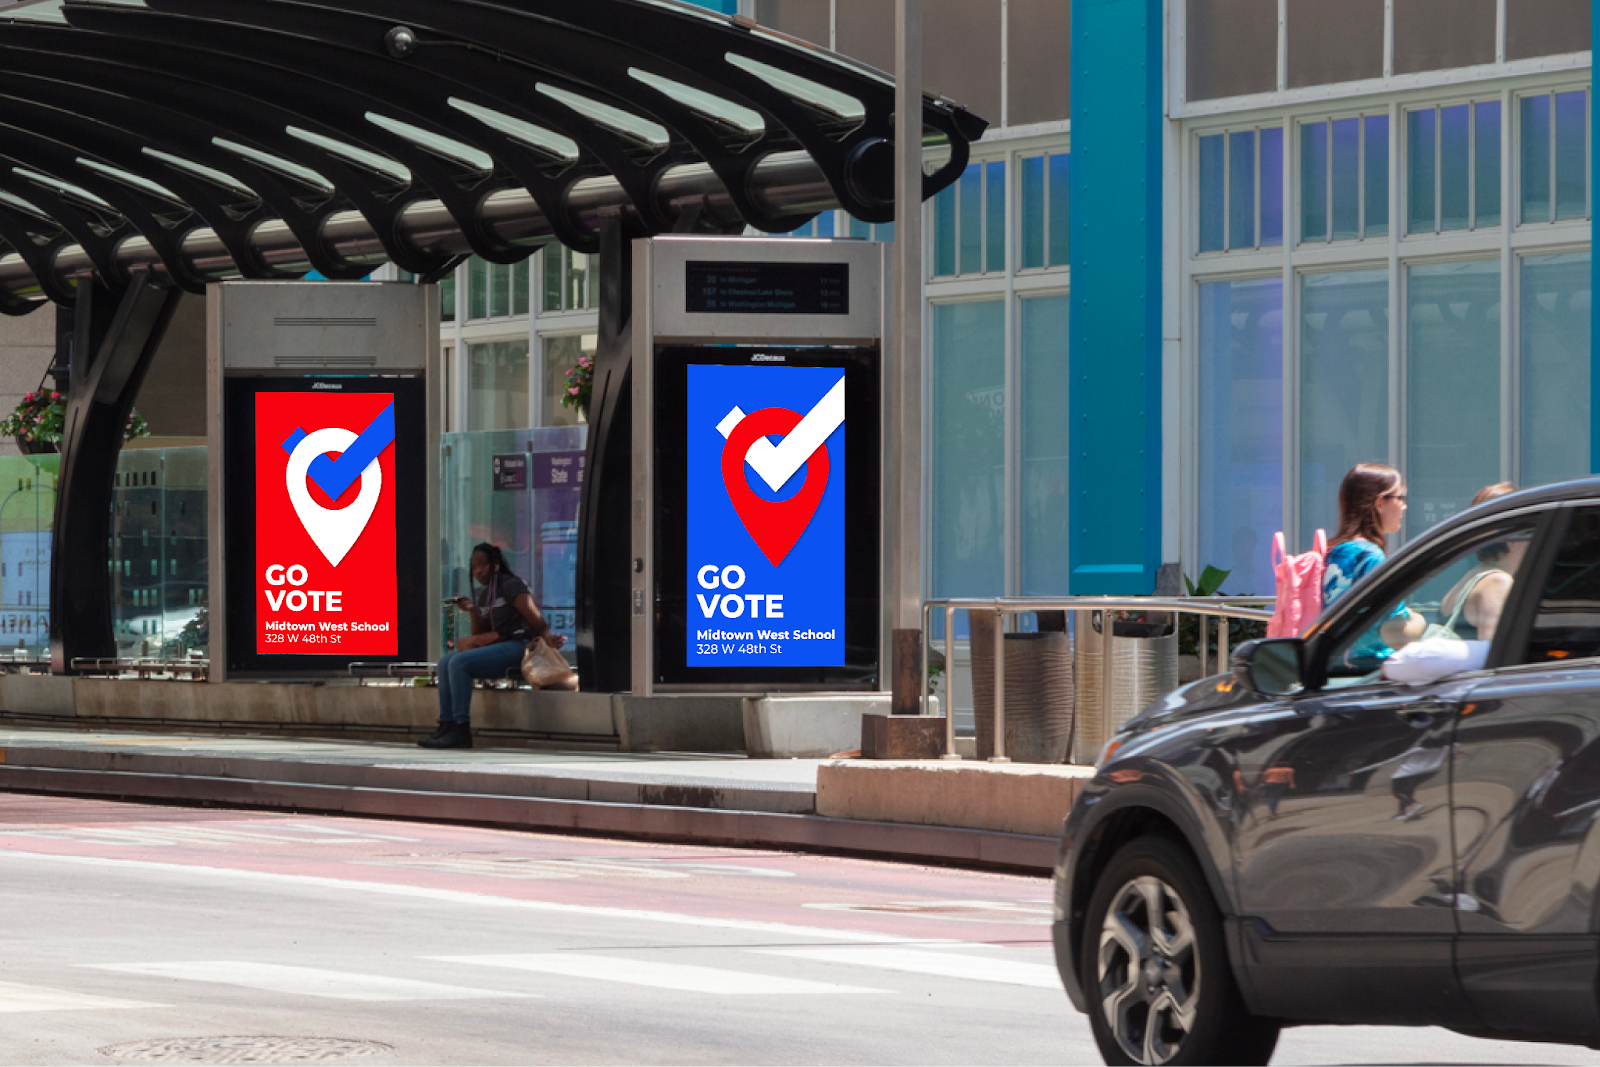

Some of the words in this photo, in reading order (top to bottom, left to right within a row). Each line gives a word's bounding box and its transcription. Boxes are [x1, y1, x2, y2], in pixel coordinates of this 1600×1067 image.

[728, 276, 758, 285] Michigan
[265, 564, 309, 587] GO
[696, 565, 746, 590] GO
[264, 590, 343, 612] VOTE
[696, 594, 784, 619] VOTE
[265, 621, 316, 632] Midtown
[318, 621, 349, 632] West
[351, 621, 390, 632] School
[265, 633, 285, 643] 328
[286, 633, 300, 643] W
[302, 633, 328, 644] 48th
[329, 633, 342, 643] St
[696, 629, 754, 641] Midtown
[757, 629, 790, 640] West
[792, 629, 836, 641] School
[696, 643, 719, 655] 328
[721, 643, 735, 654] W
[737, 643, 767, 655] 48th
[769, 643, 783, 654] St
